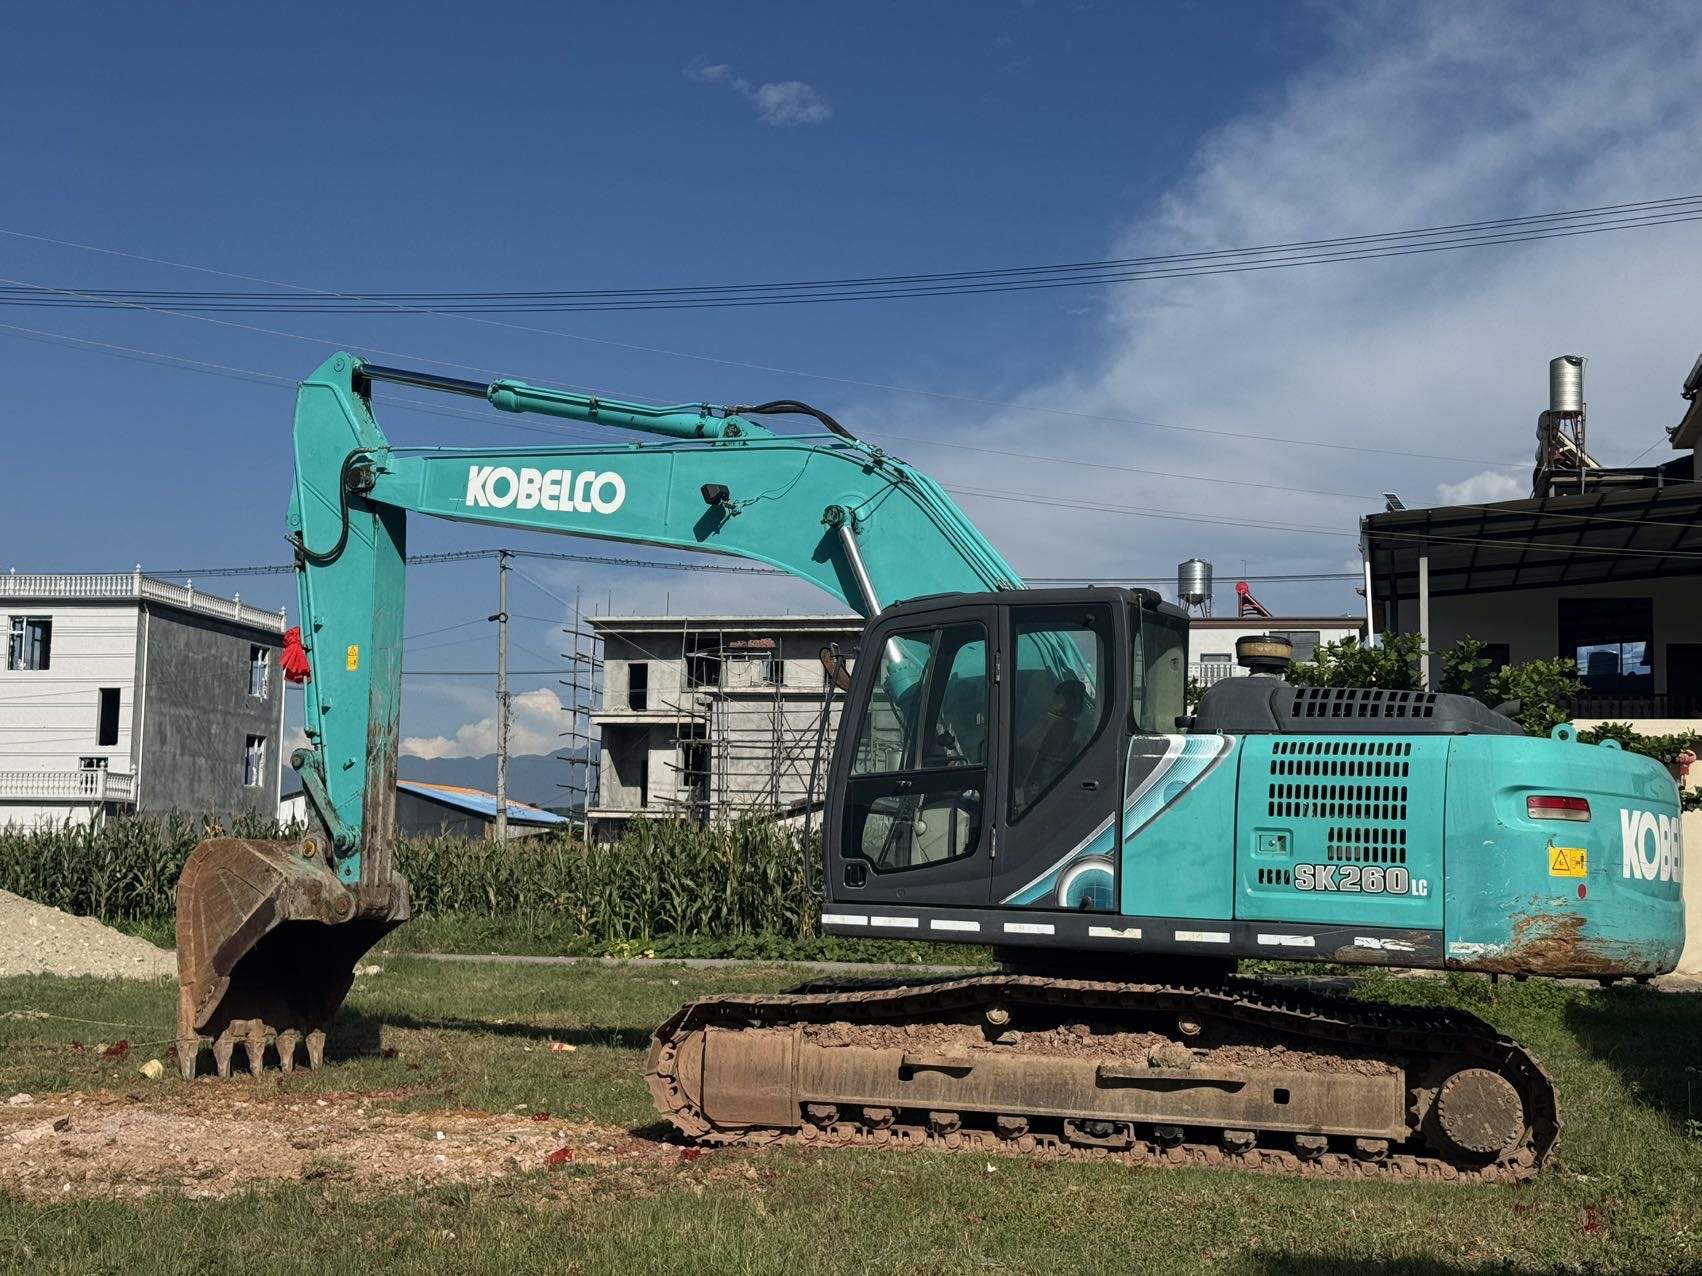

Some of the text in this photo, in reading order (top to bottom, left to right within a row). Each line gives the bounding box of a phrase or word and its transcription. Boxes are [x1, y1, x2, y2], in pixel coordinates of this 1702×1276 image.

[465, 465, 626, 514] KOBELCO
[1294, 864, 1427, 896] SK260 LC
